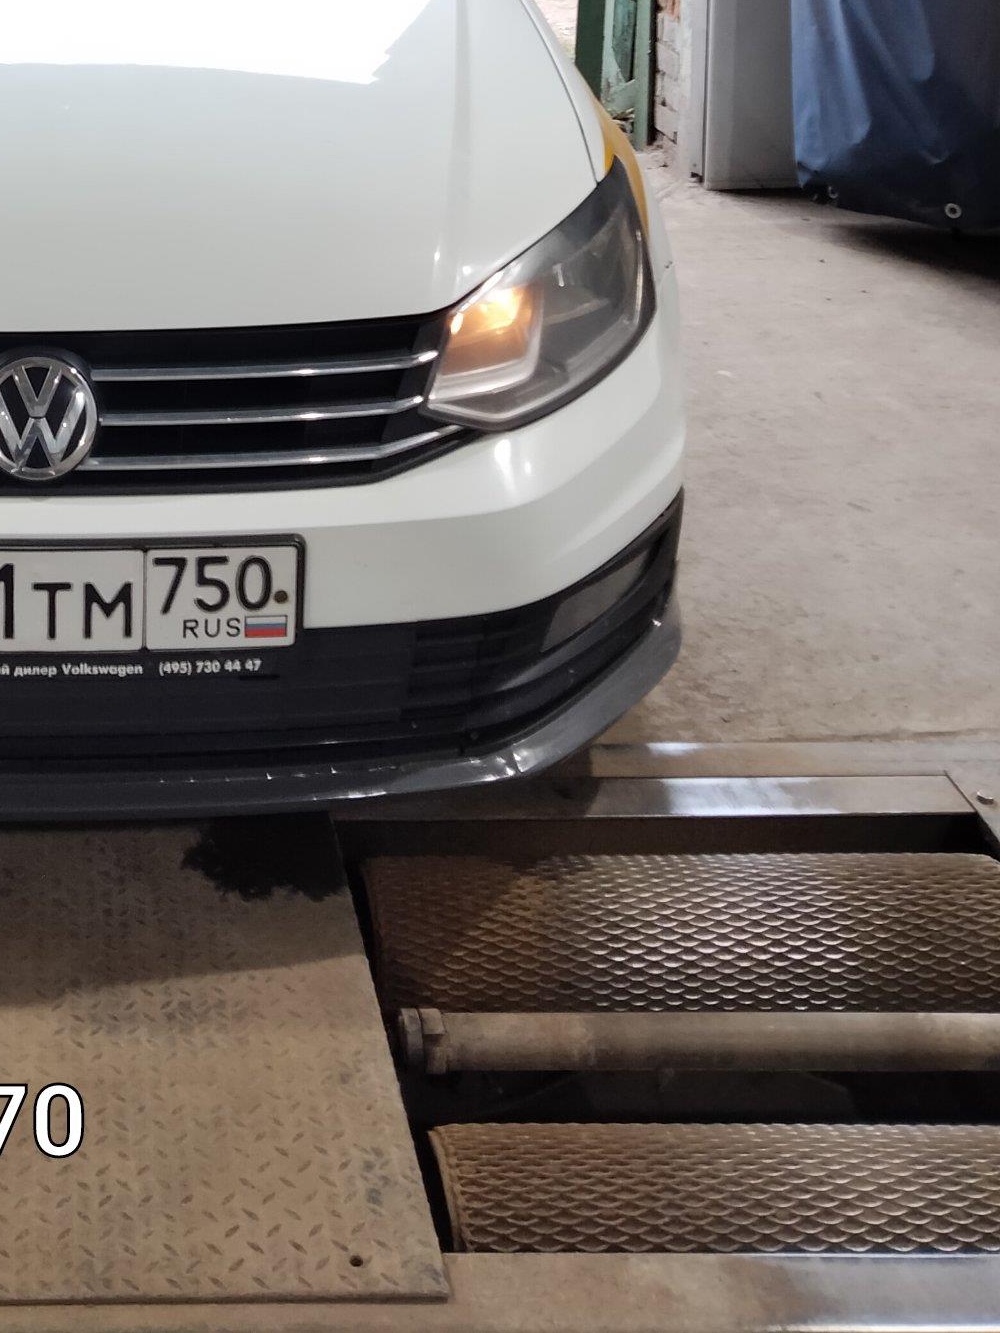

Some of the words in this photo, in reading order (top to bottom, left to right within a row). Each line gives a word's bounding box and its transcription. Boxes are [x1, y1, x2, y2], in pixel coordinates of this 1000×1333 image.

[151, 554, 275, 615] 750
[182, 616, 242, 639] RUS
[13, 664, 58, 678] дилер
[61, 662, 144, 678] Volkswagen
[158, 660, 192, 677] (495)
[195, 660, 221, 674] 730
[223, 660, 242, 673] 44
[244, 658, 263, 672] 47
